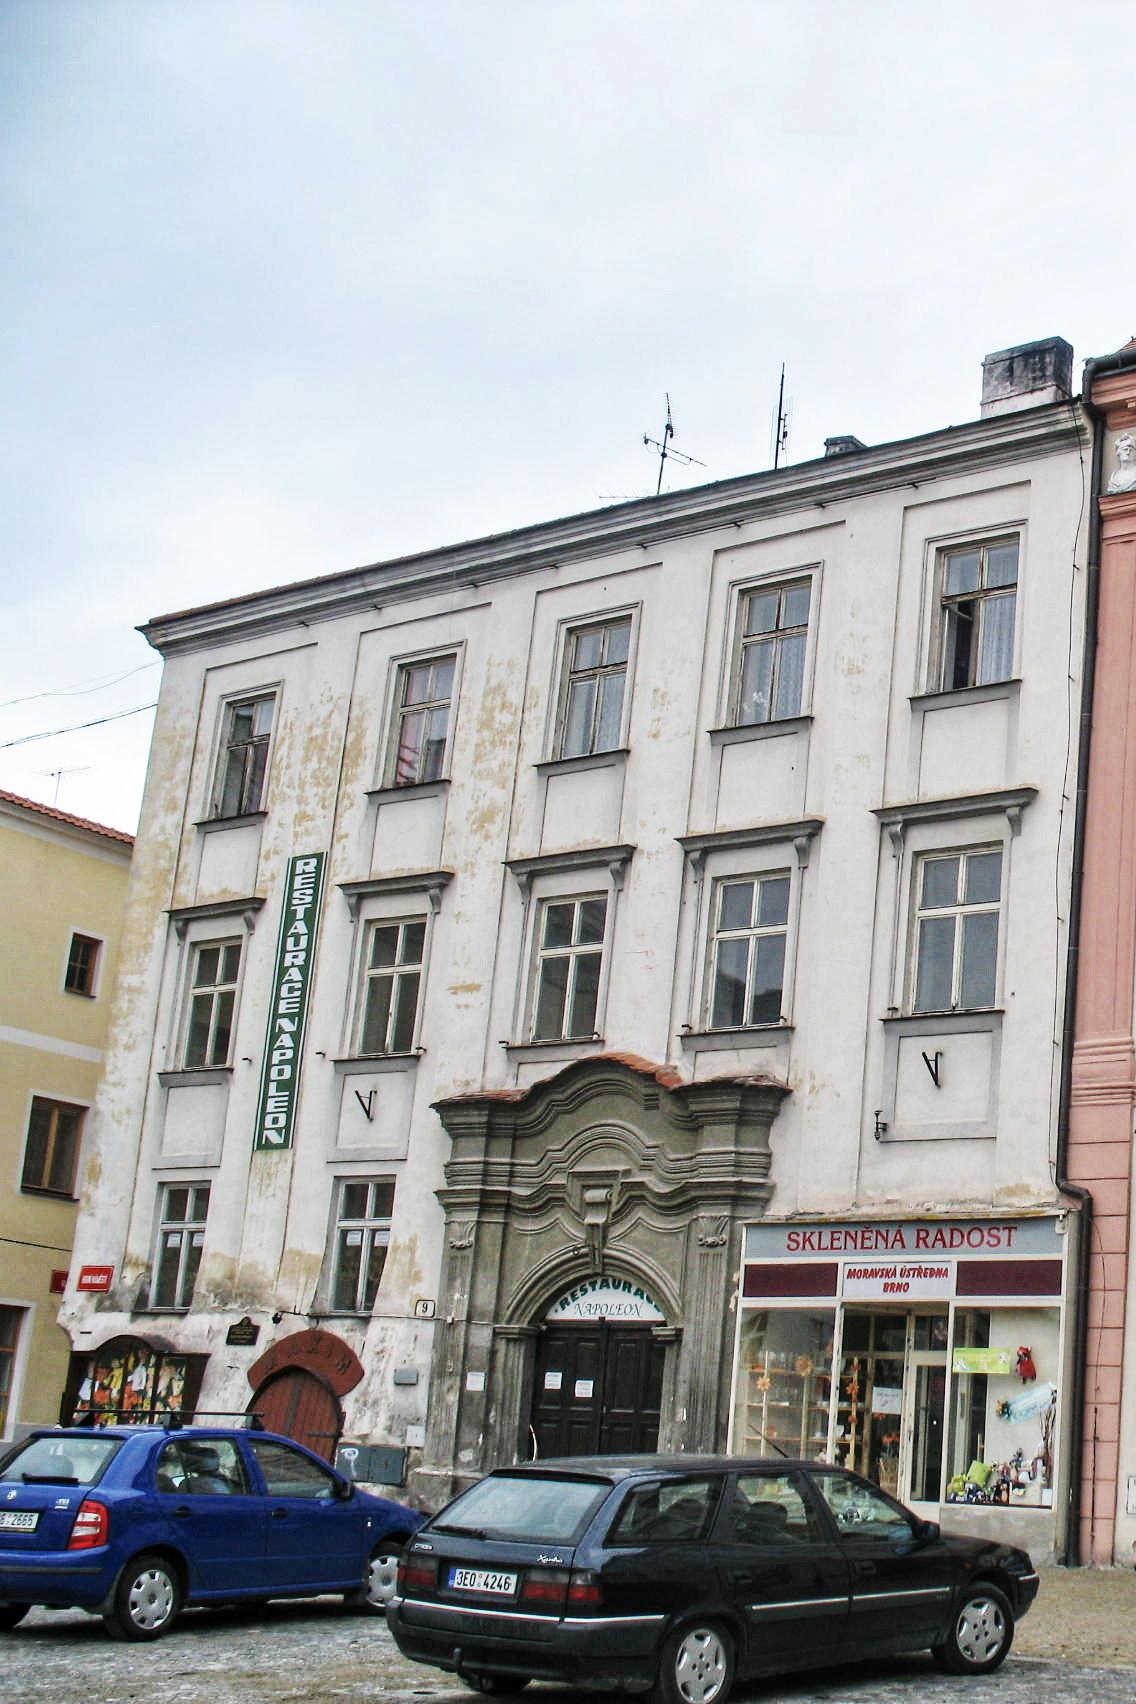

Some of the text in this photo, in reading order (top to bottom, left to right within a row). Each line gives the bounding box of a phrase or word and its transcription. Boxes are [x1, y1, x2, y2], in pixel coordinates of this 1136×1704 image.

[262, 857, 317, 1145] RESTAURACE NAPOLEON
[786, 1225, 1018, 1251] SKLENĚNÁ RADOST
[846, 1266, 949, 1280] MORAVSKÁ ÚSTŘEDNA
[882, 1282, 910, 1293] BRNO
[421, 1302, 428, 1313] 9
[574, 1303, 643, 1317] NAPOLEON
[483, 1576, 512, 1591] 4246
